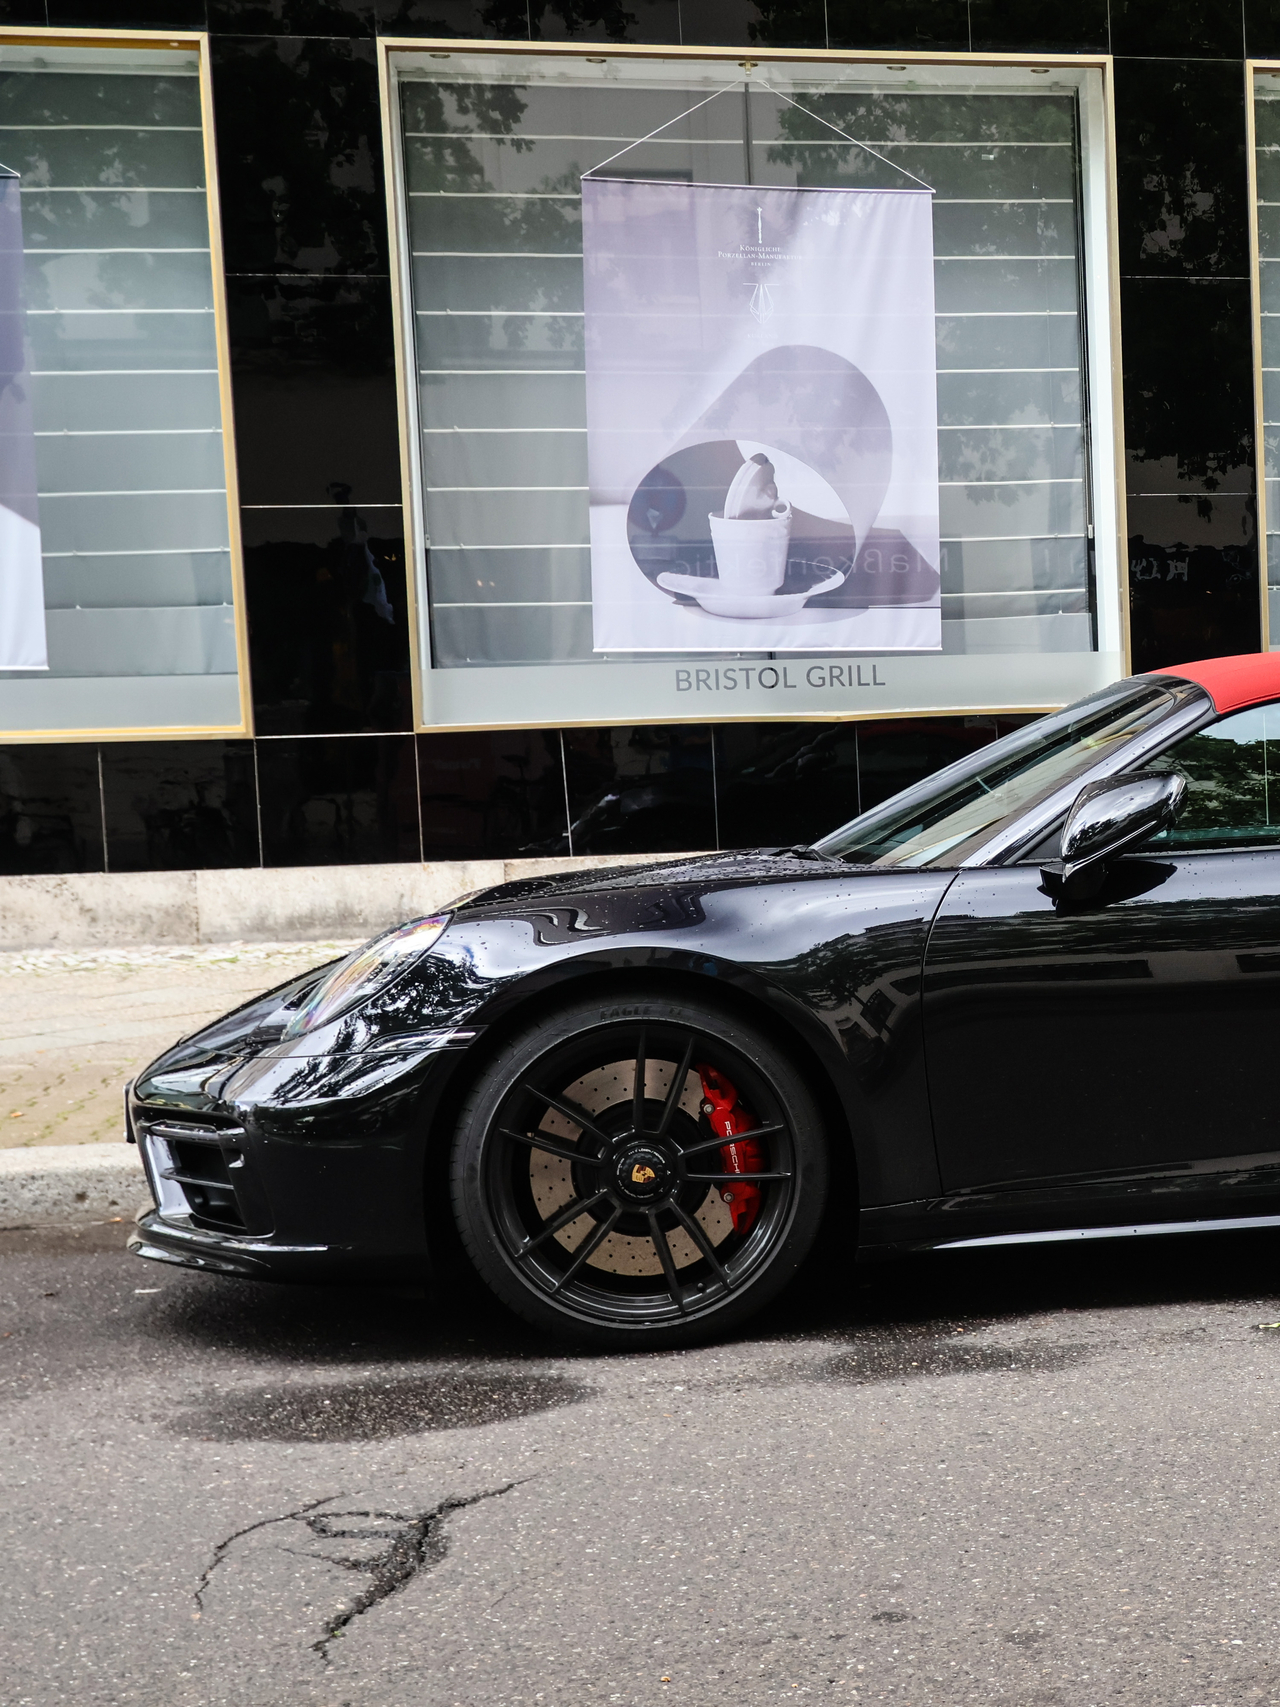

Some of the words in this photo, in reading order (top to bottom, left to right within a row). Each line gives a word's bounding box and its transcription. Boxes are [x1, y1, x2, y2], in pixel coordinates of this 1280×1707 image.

[739, 244, 781, 252] KÖNIGLICHE
[675, 666, 797, 691] BRISTOL
[806, 664, 886, 688] GRILL
[600, 1005, 653, 1020] EAGLE
[724, 1120, 741, 1174] POSCH
